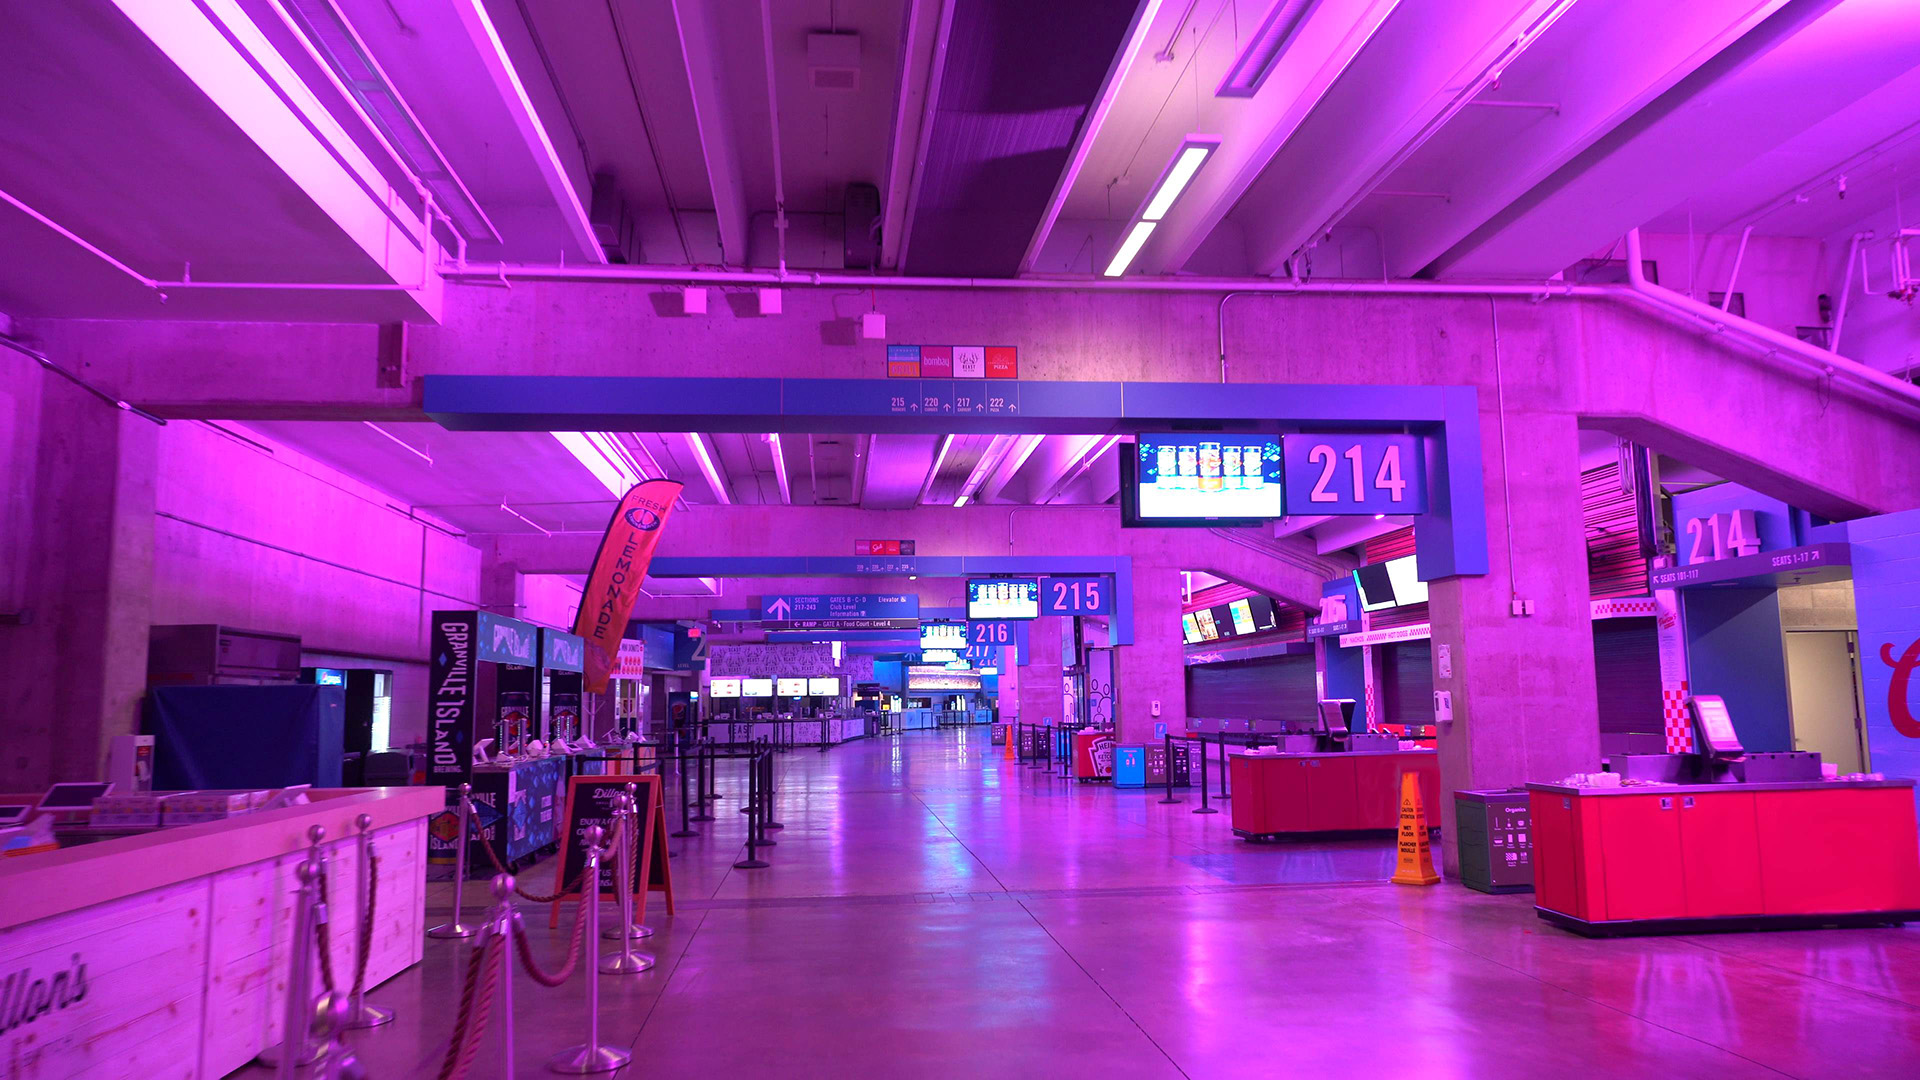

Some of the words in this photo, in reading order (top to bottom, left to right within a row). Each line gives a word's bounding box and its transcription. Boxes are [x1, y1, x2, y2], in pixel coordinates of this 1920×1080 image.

[924, 356, 950, 367] bombay
[891, 397, 905, 406] 215
[924, 397, 939, 407] 220
[957, 397, 970, 407] 217
[990, 398, 1004, 407] 222
[1308, 444, 1406, 502] 214
[632, 495, 667, 513] FRESH
[1687, 509, 1761, 566] 214
[1772, 556, 1792, 567] SEATS
[1793, 551, 1809, 564] 1-17
[1660, 573, 1676, 583] SEATS
[1677, 569, 1699, 581] 101-117
[594, 532, 638, 639] LEMONADE
[1053, 582, 1100, 610] 215
[976, 624, 1007, 643] 216
[436, 622, 469, 695] GRANVILLE
[432, 700, 466, 765] ISLAND
[579, 818, 601, 826] ENJOY
